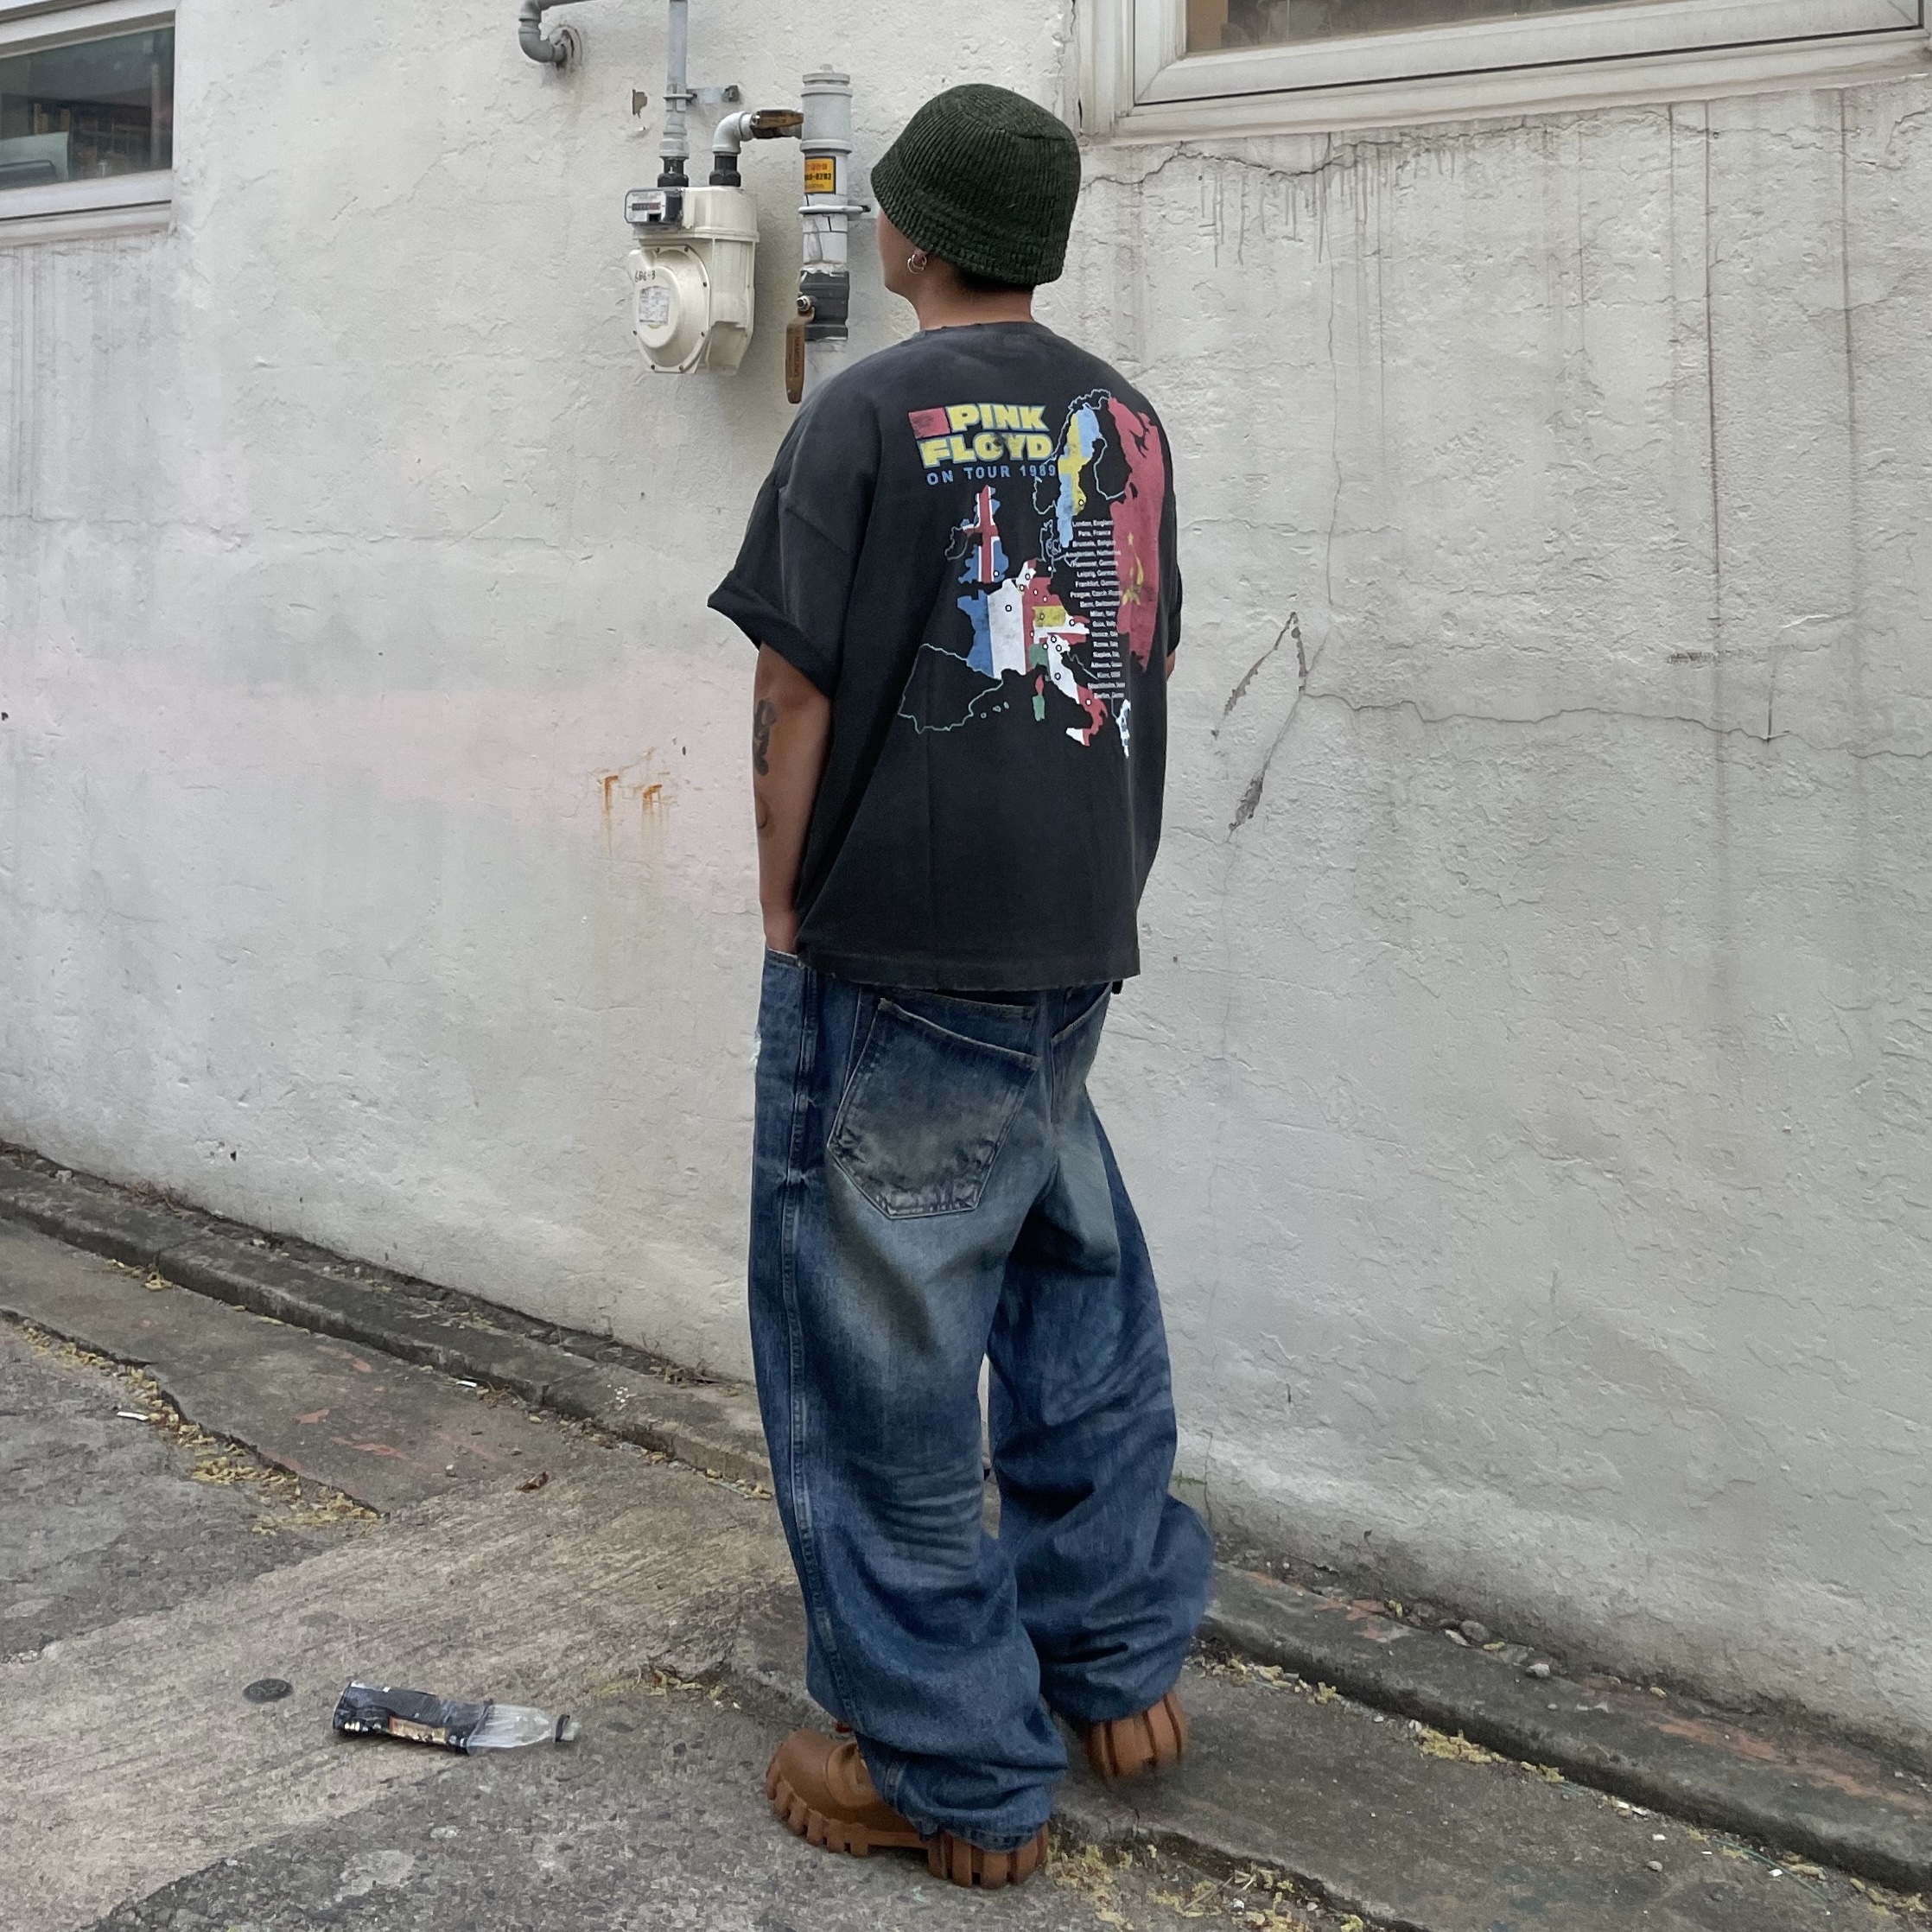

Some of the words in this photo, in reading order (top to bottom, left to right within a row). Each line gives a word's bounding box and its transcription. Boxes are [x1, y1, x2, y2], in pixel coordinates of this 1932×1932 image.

[945, 403, 1049, 432] PINK
[917, 432, 1054, 469] FLOYD
[926, 470, 954, 486] ON
[963, 465, 1012, 480] TOUR
[1020, 465, 1056, 477] 1989
